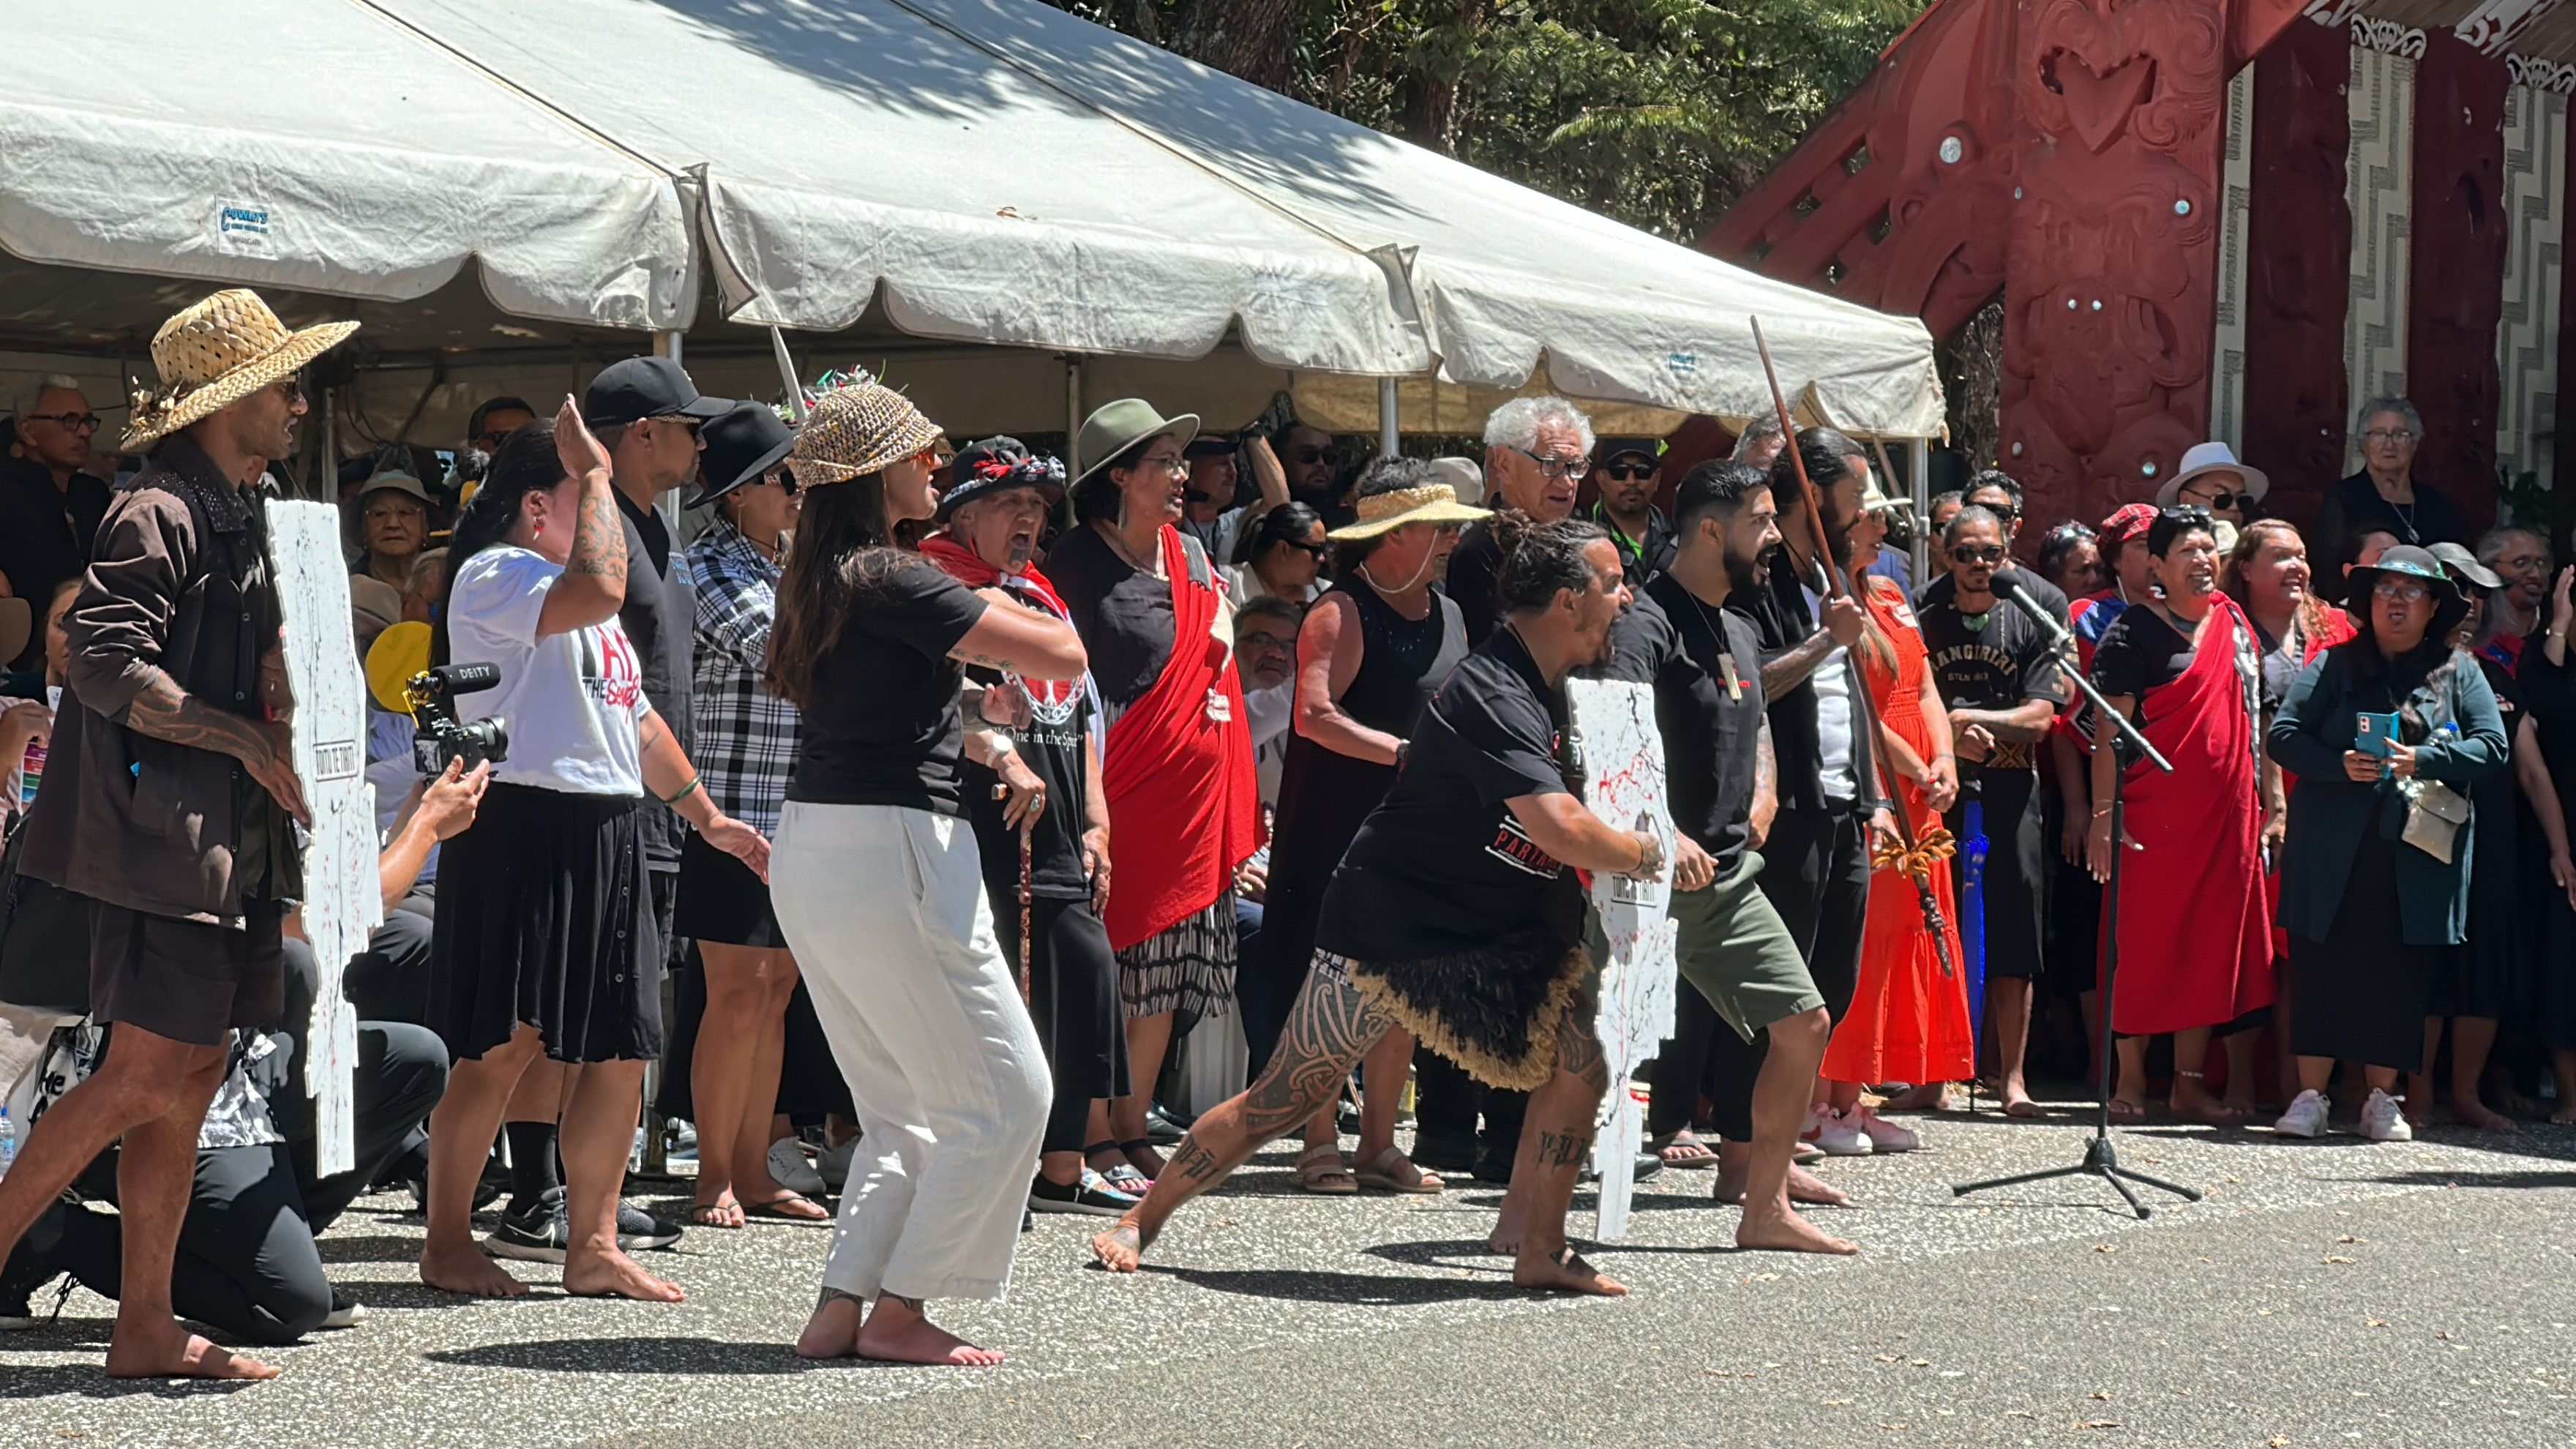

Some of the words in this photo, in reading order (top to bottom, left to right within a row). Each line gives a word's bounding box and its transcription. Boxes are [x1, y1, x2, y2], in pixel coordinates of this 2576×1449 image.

[459, 666, 490, 679] DEITY
[583, 678, 607, 699] THE
[1033, 729, 1044, 744] in
[1045, 729, 1062, 746] the
